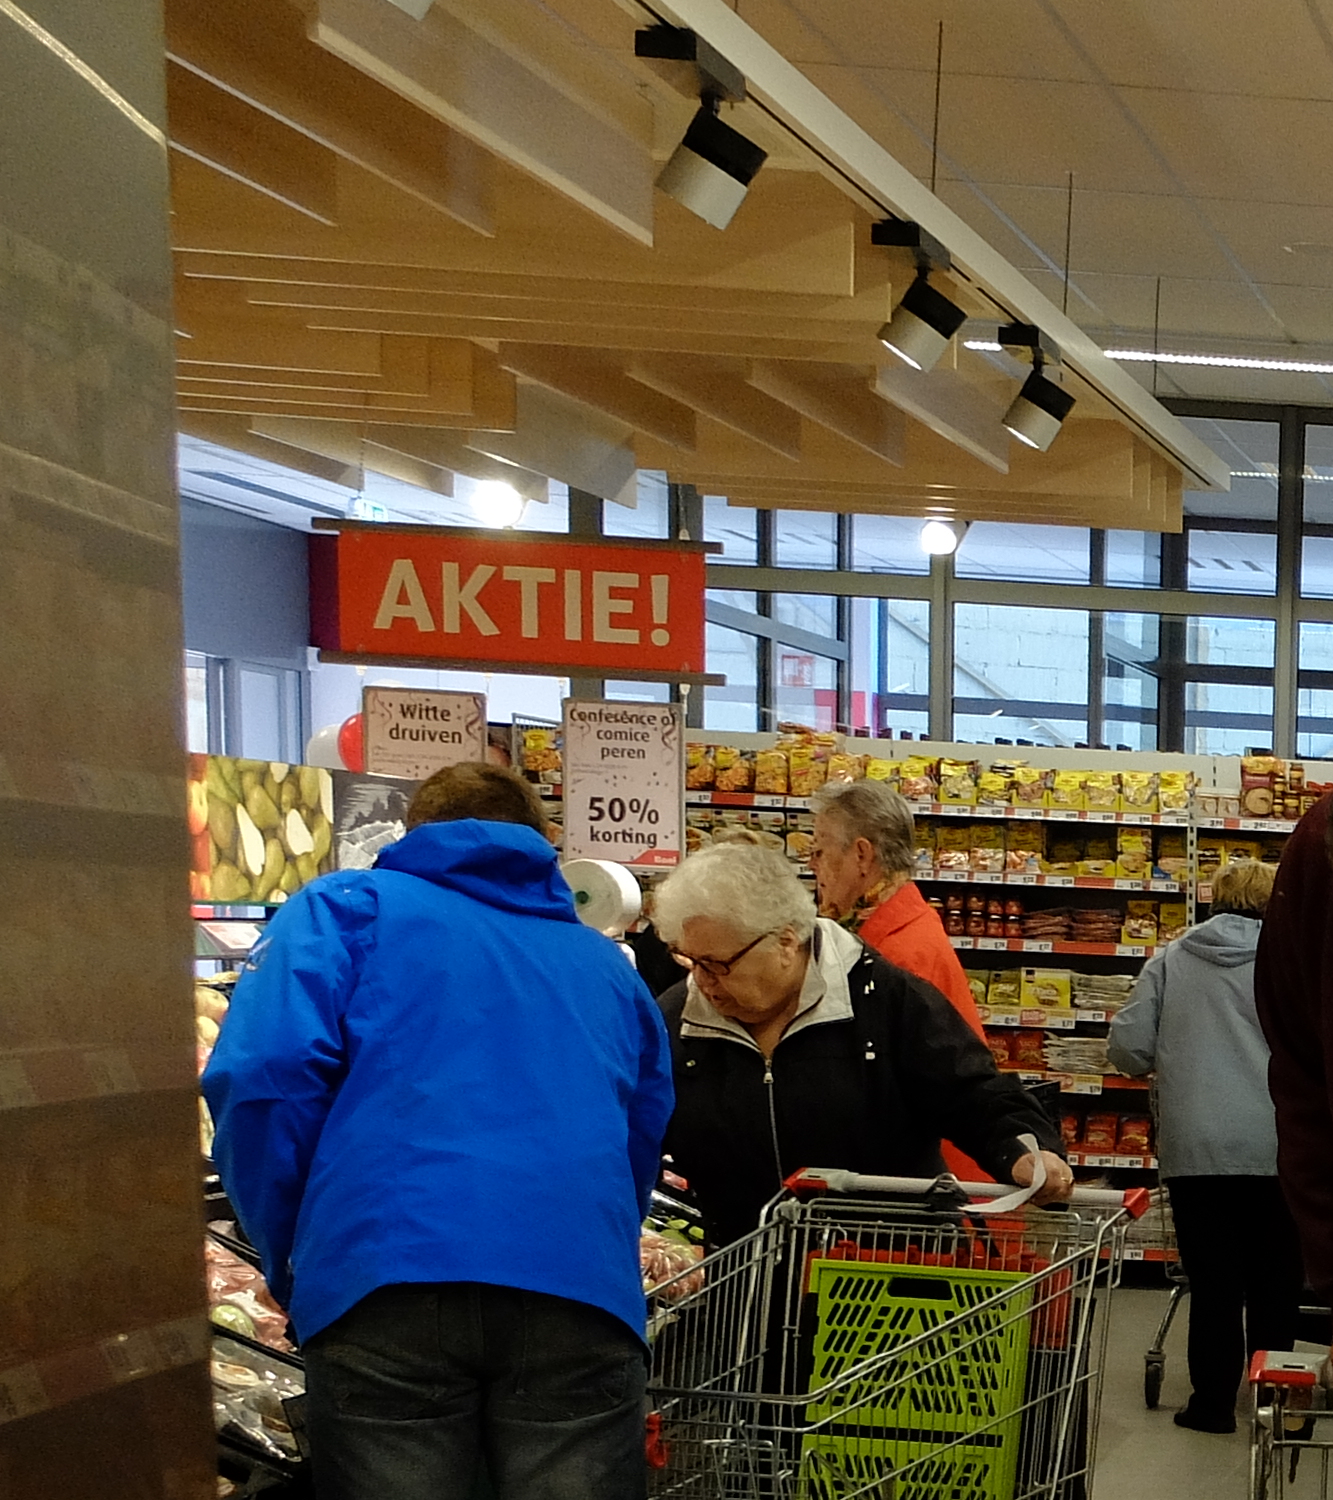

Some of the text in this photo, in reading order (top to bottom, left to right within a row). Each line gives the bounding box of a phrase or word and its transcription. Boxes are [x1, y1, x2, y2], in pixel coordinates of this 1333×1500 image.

[374, 558, 671, 646] AKTIE!
[399, 703, 451, 723] Witte
[389, 723, 463, 745] druiven
[596, 727, 650, 743] comice
[601, 746, 646, 762] peren
[587, 797, 660, 825] 50%
[590, 826, 659, 849] korting
